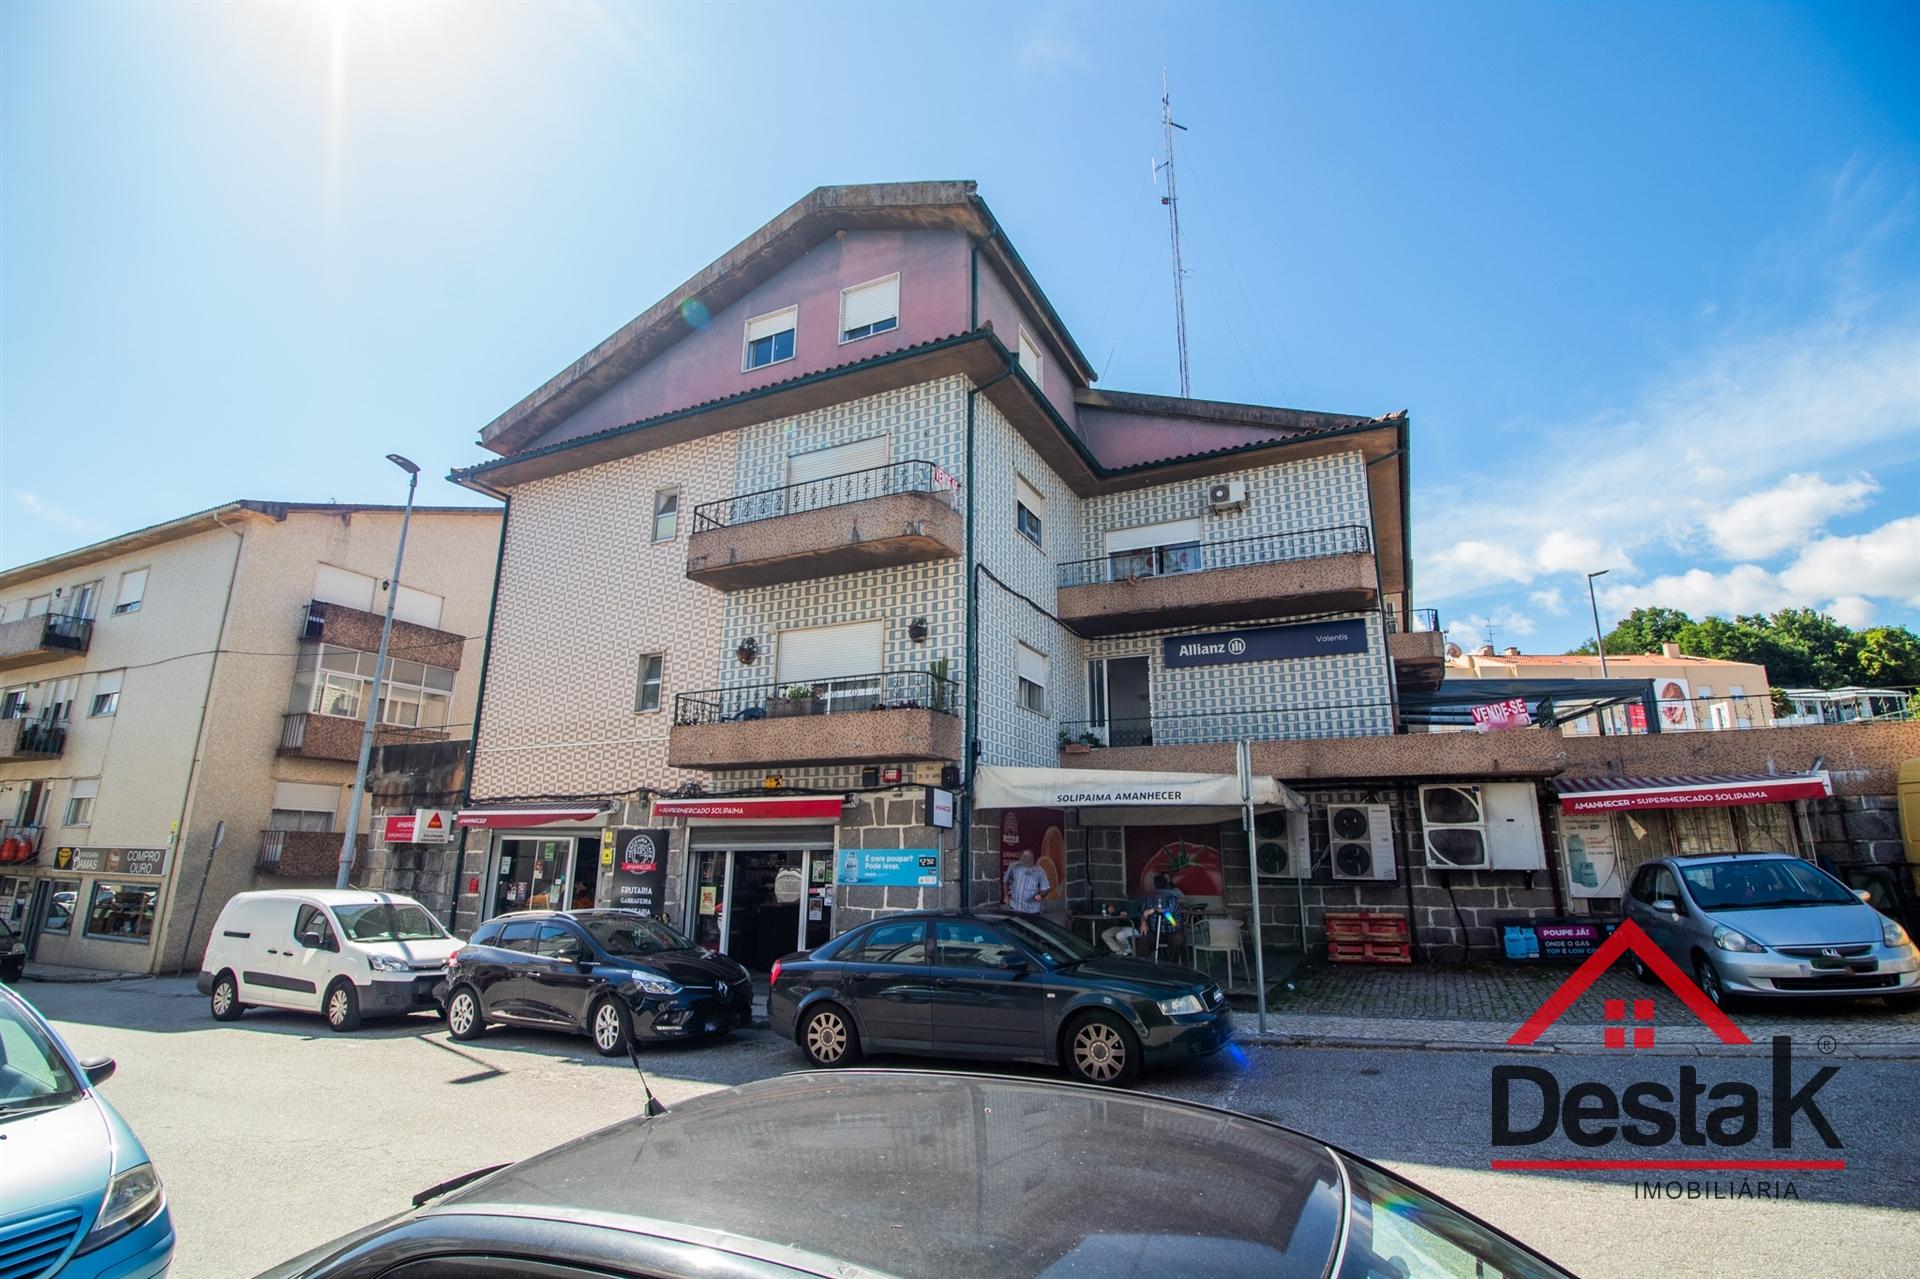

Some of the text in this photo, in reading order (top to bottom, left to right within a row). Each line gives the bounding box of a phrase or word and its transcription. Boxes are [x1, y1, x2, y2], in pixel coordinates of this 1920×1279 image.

[1316, 633, 1349, 643] Valentis
[1179, 643, 1225, 656] Allianz
[1057, 791, 1182, 803] SOLIPAIMA AMANHECER
[1574, 791, 1767, 810] AMANHECER SUPERMERCADO SOLIPAIMA
[127, 850, 160, 862] COMPRO
[129, 863, 153, 874] OURO
[621, 886, 653, 895] FRUTARIA
